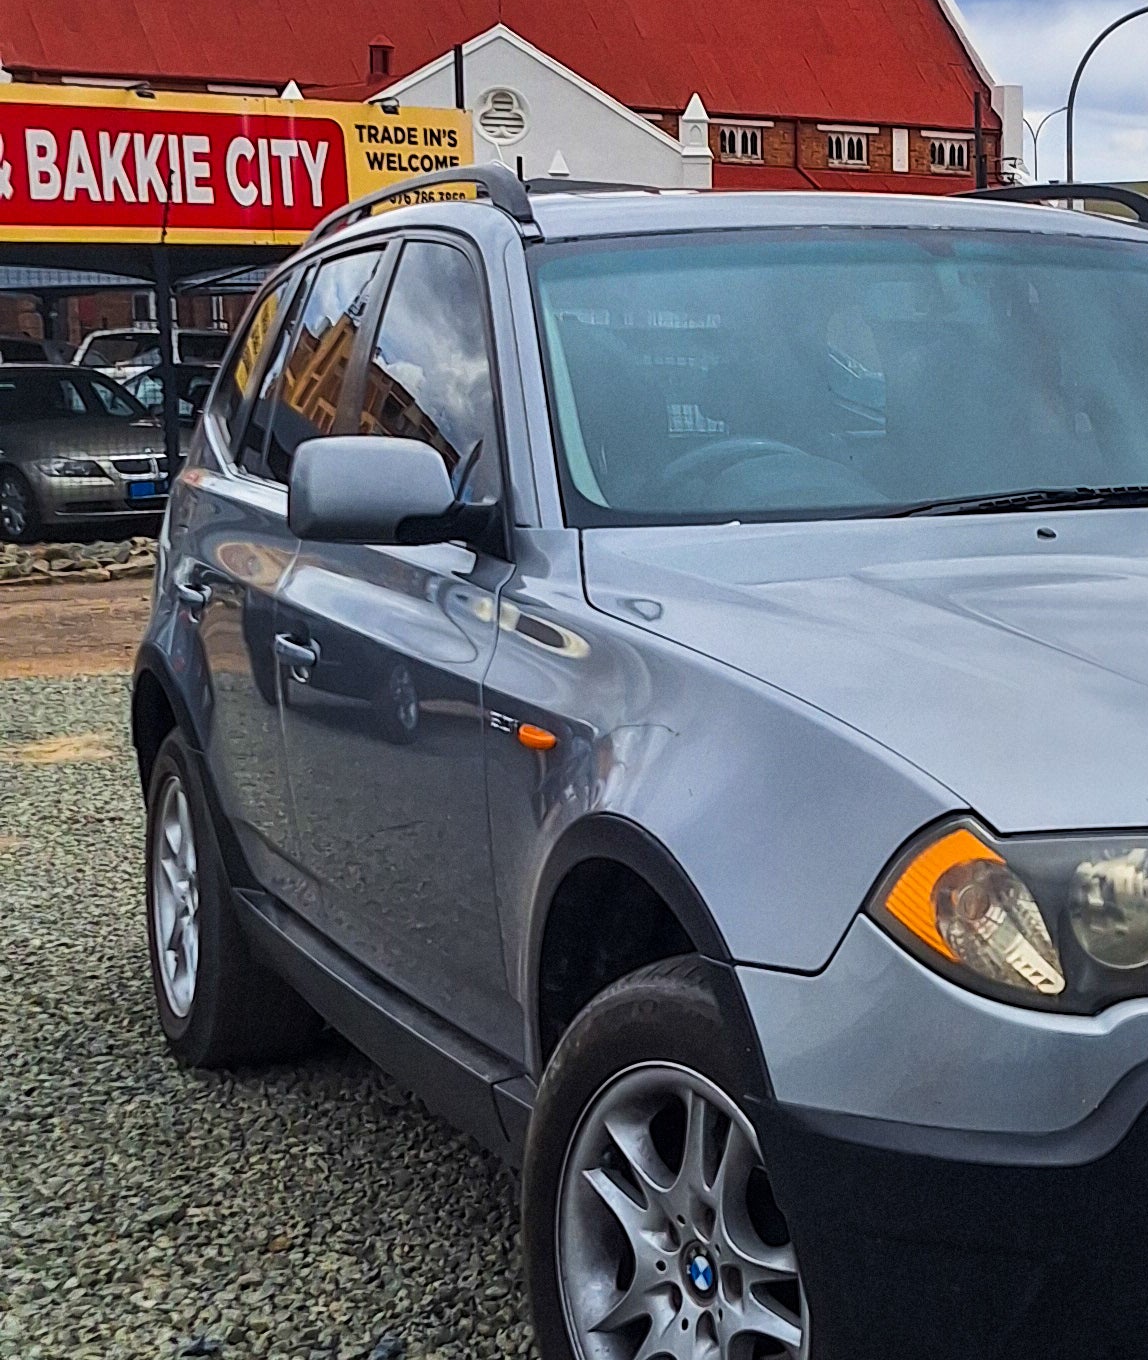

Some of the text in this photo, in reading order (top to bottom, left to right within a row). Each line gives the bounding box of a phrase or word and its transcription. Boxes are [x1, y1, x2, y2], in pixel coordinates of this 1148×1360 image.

[354, 124, 458, 148] TRADE IN'S
[24, 128, 215, 205] BAKKIE
[225, 136, 329, 207] CITY
[365, 151, 460, 173] WELCOME
